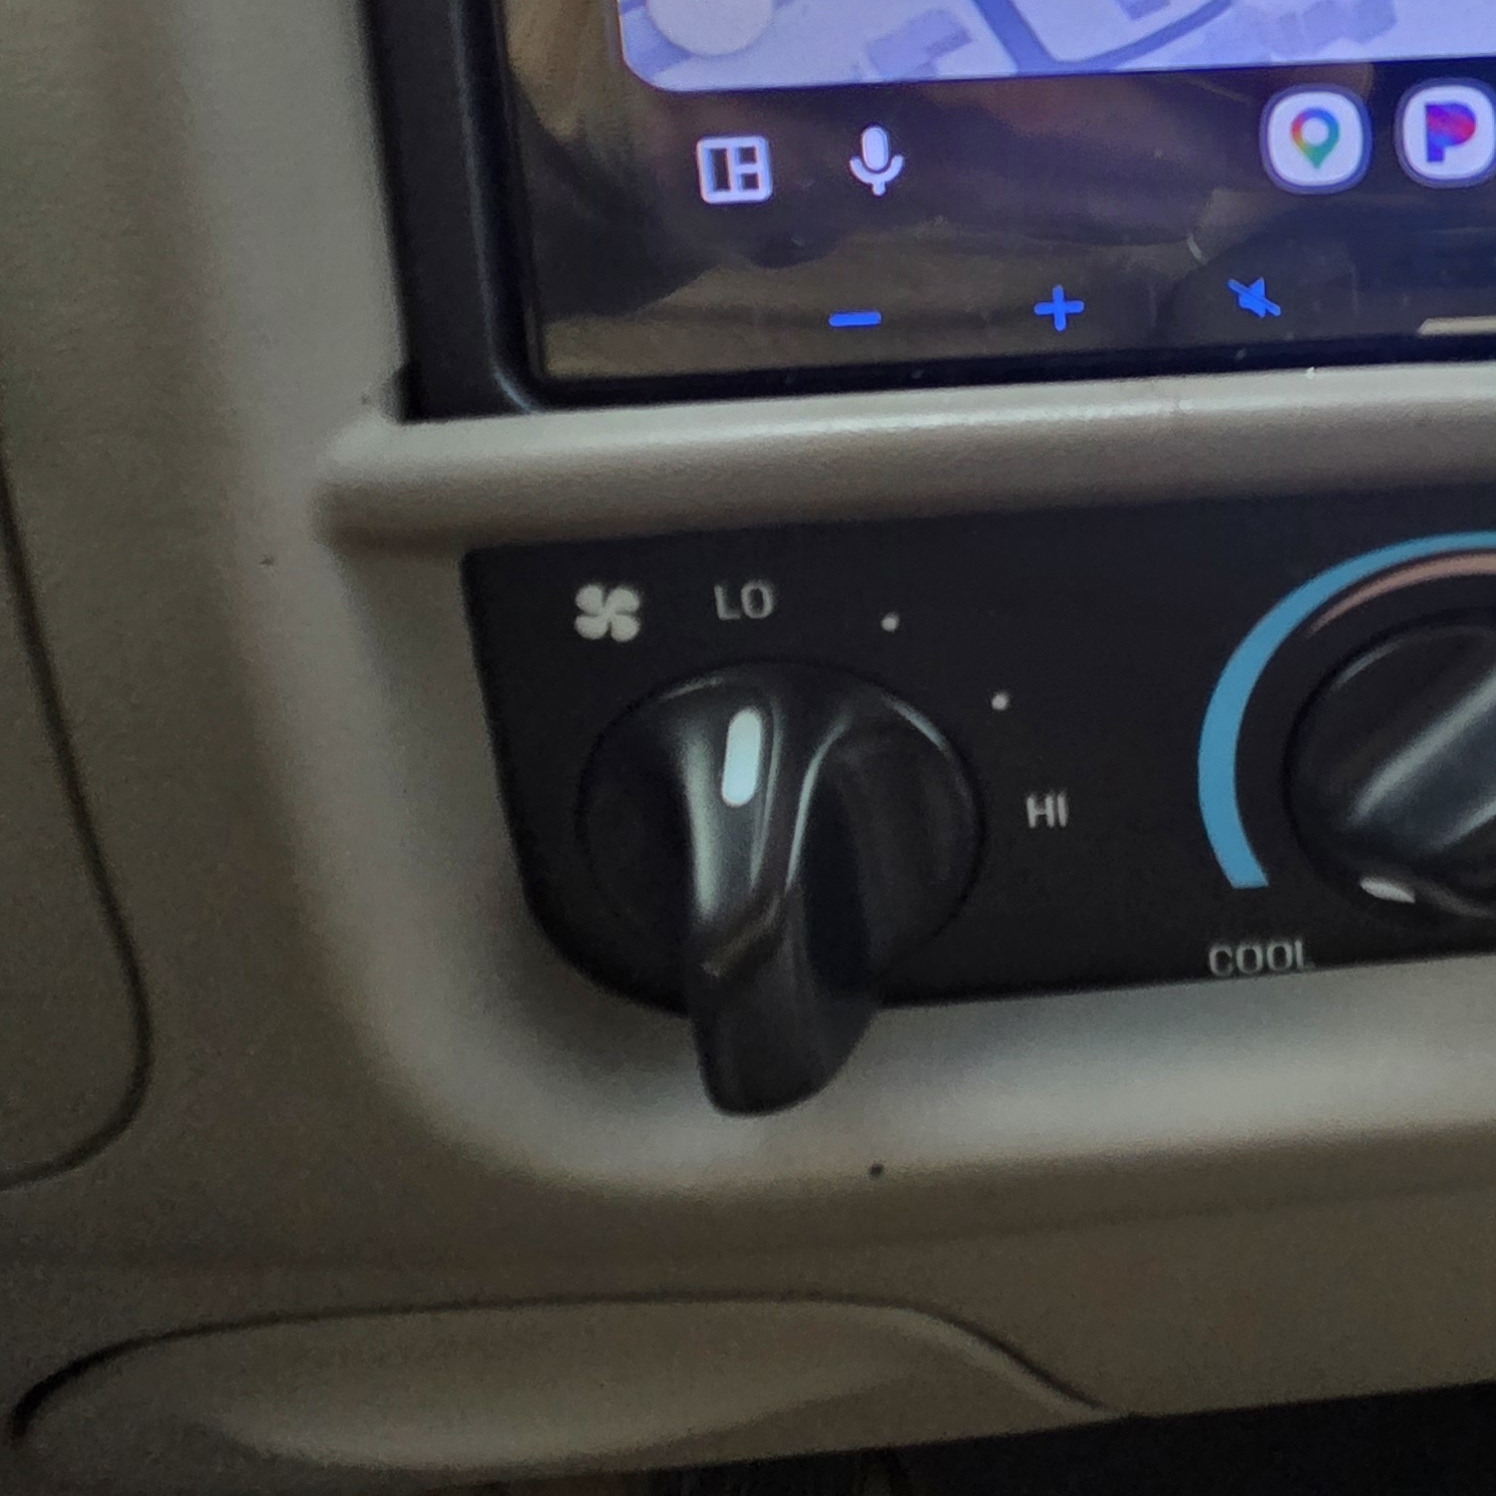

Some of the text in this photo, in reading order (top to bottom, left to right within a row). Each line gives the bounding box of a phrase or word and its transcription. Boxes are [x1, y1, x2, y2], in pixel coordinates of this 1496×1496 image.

[713, 581, 775, 620] LO
[1026, 791, 1069, 829] HI
[1208, 940, 1314, 978] COOL
